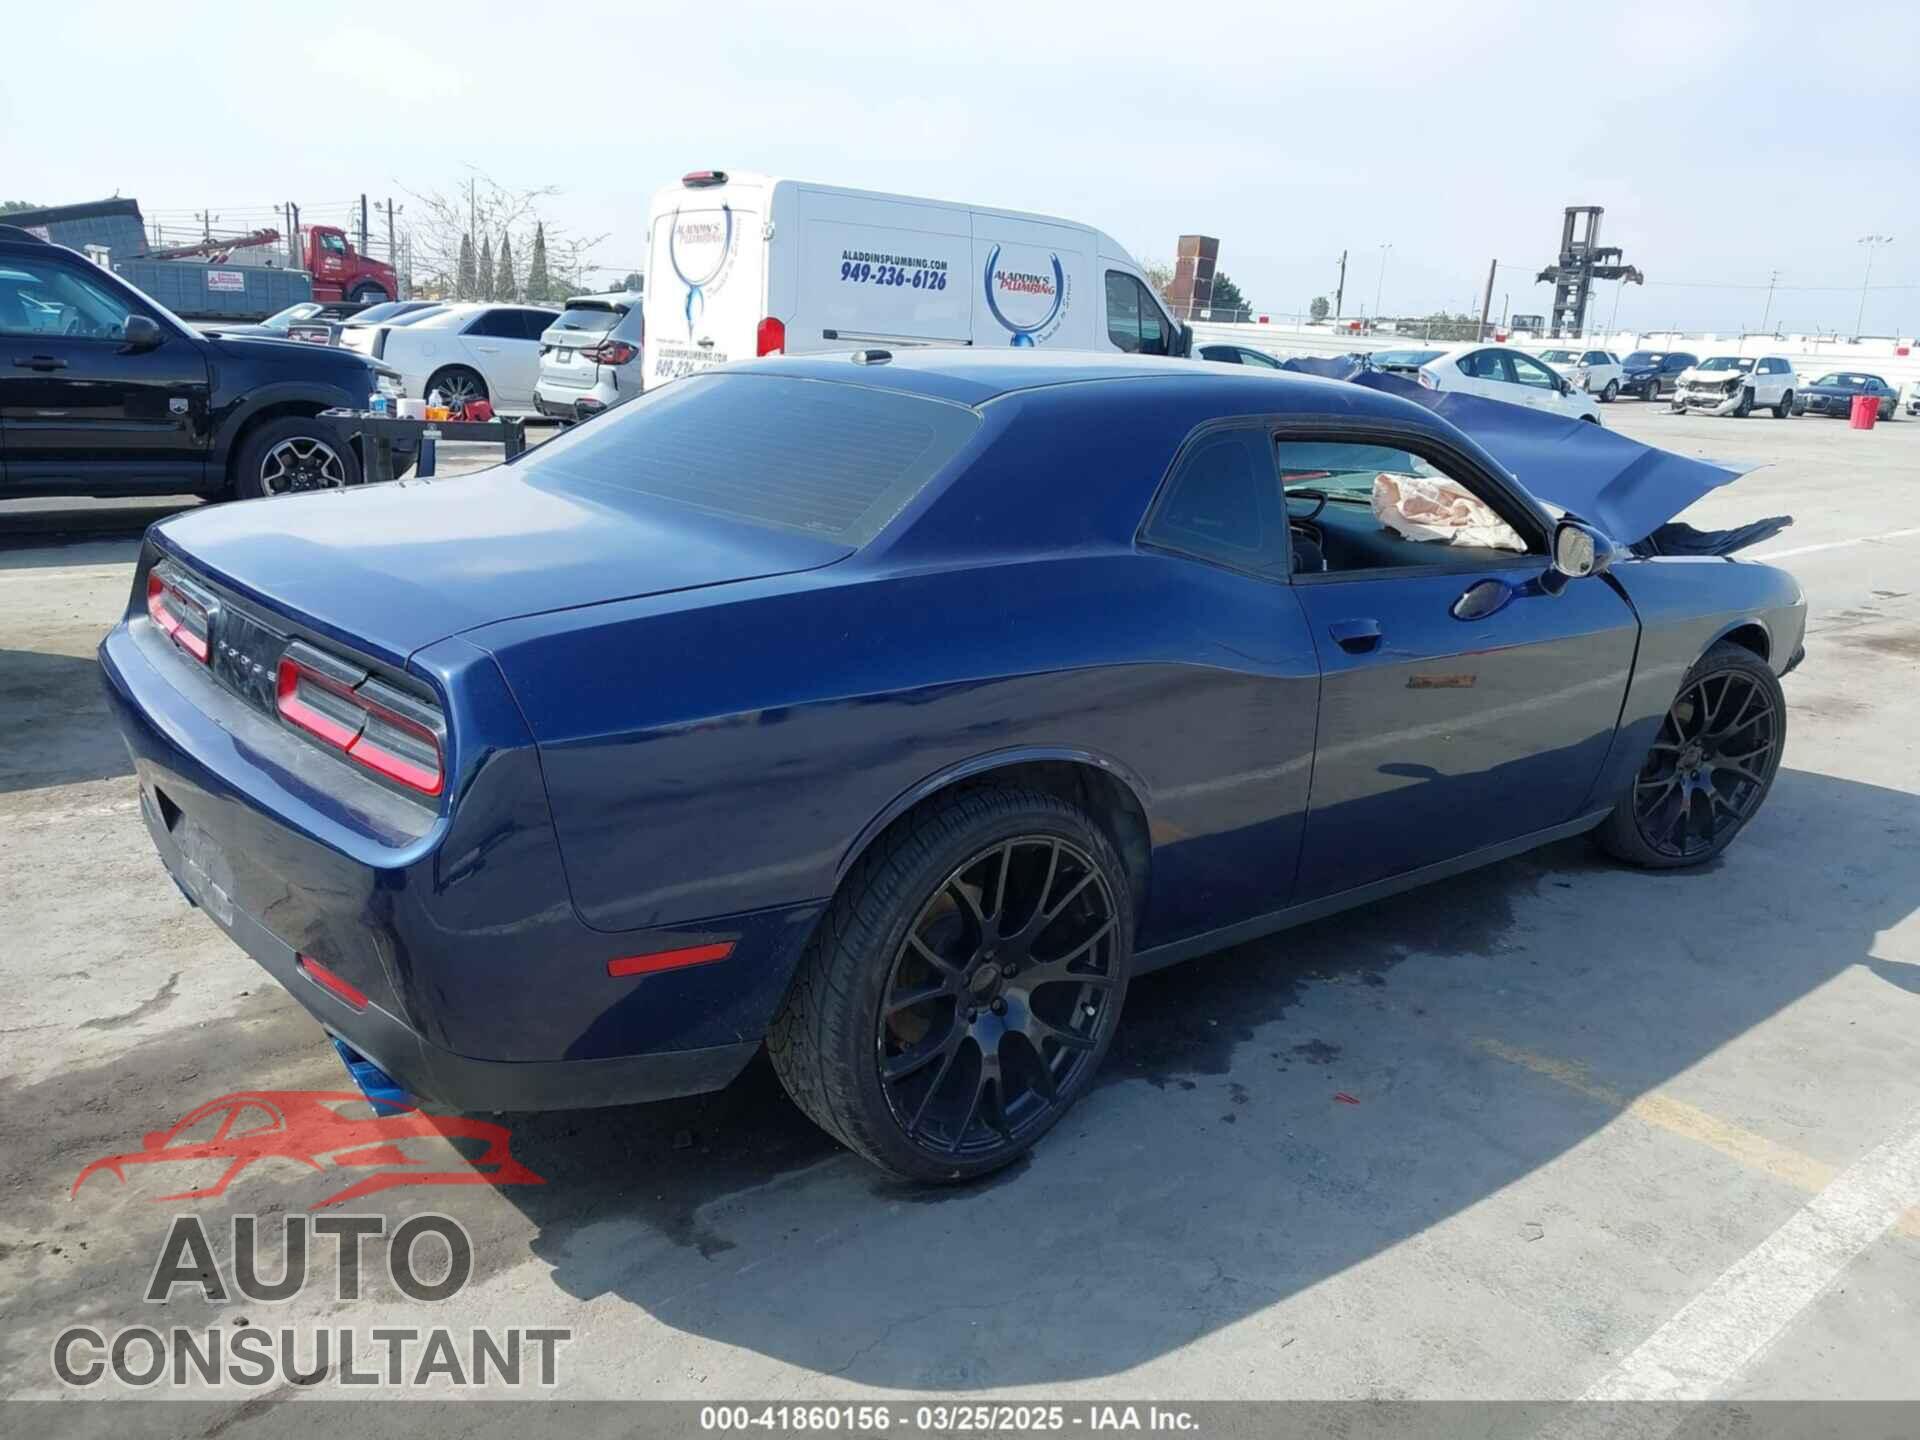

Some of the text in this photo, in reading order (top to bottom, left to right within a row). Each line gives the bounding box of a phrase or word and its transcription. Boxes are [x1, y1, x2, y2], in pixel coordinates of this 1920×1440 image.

[841, 250, 947, 270] ALADDINSPLUMBING.COM
[841, 262, 947, 290] 949-236-6126
[995, 270, 1050, 285] ALADDIN'S
[1000, 279, 1055, 295] PLUMBING
